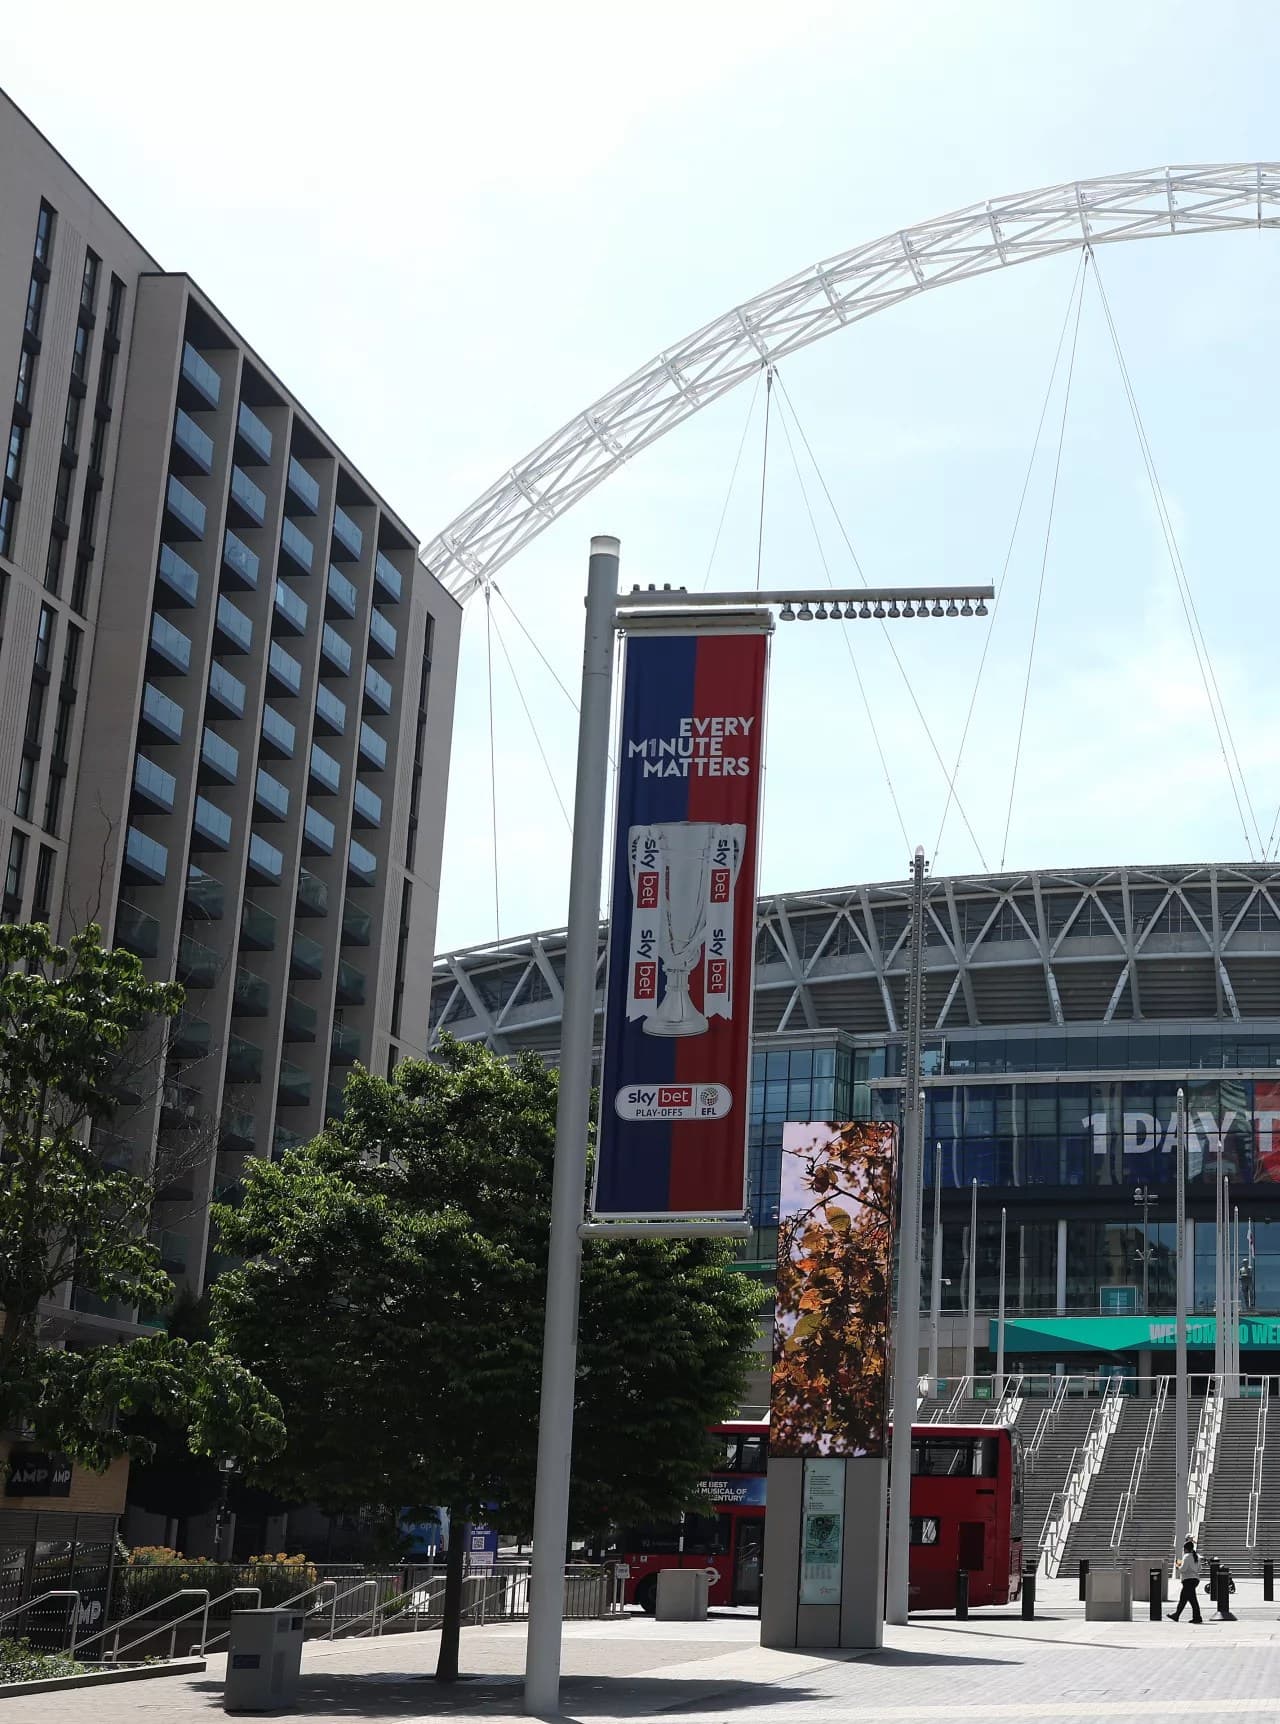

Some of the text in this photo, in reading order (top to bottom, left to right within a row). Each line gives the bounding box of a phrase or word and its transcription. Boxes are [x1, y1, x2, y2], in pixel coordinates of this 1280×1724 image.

[679, 717, 754, 736] EVERY
[643, 757, 750, 778] MATTERS
[640, 838, 660, 905] sky bet
[713, 839, 731, 900] sky bet
[637, 929, 656, 996] sky bet
[709, 928, 727, 991] sky bet
[628, 1089, 689, 1106] sky bet
[635, 1108, 683, 1117] PLAY-OFFS
[701, 1107, 717, 1116] EFL
[1082, 1112, 1108, 1154] 1
[1123, 1111, 1236, 1154] DAY
[52, 1469, 71, 1483] AMP
